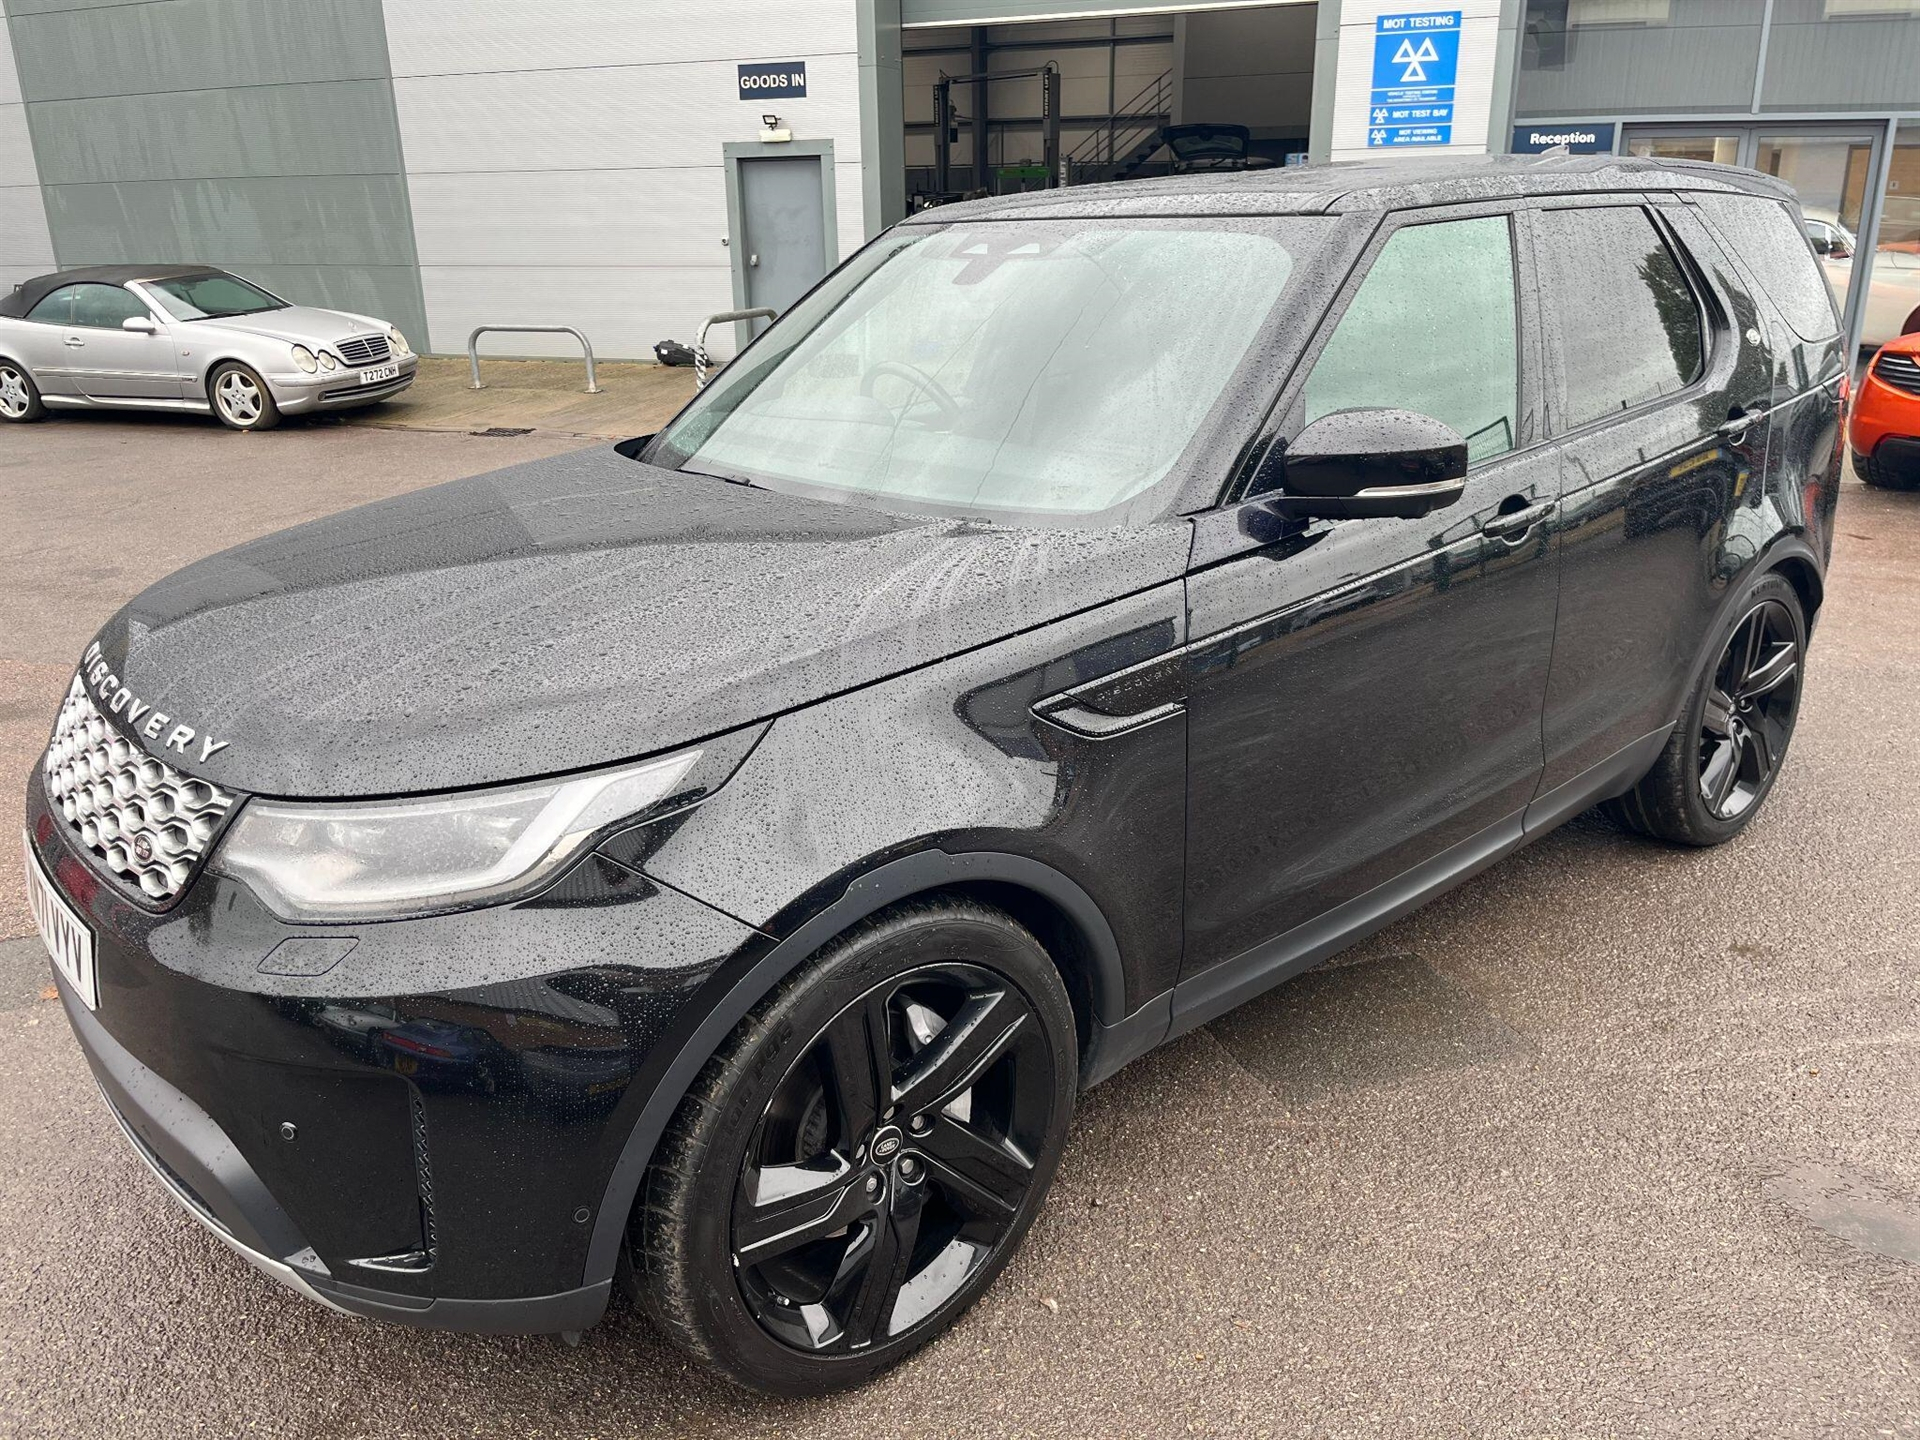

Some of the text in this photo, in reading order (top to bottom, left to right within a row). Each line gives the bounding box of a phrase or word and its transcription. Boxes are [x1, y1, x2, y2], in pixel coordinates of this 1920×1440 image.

[1383, 15, 1454, 29] MOT TESTING
[740, 73, 804, 89] GOODS IN
[1392, 108, 1448, 118] MOT TEST BAY
[1529, 132, 1595, 145] Reception
[363, 365, 397, 381] T272 CNH
[84, 641, 230, 763] DISCOVERY
[50, 899, 82, 982] VYV
